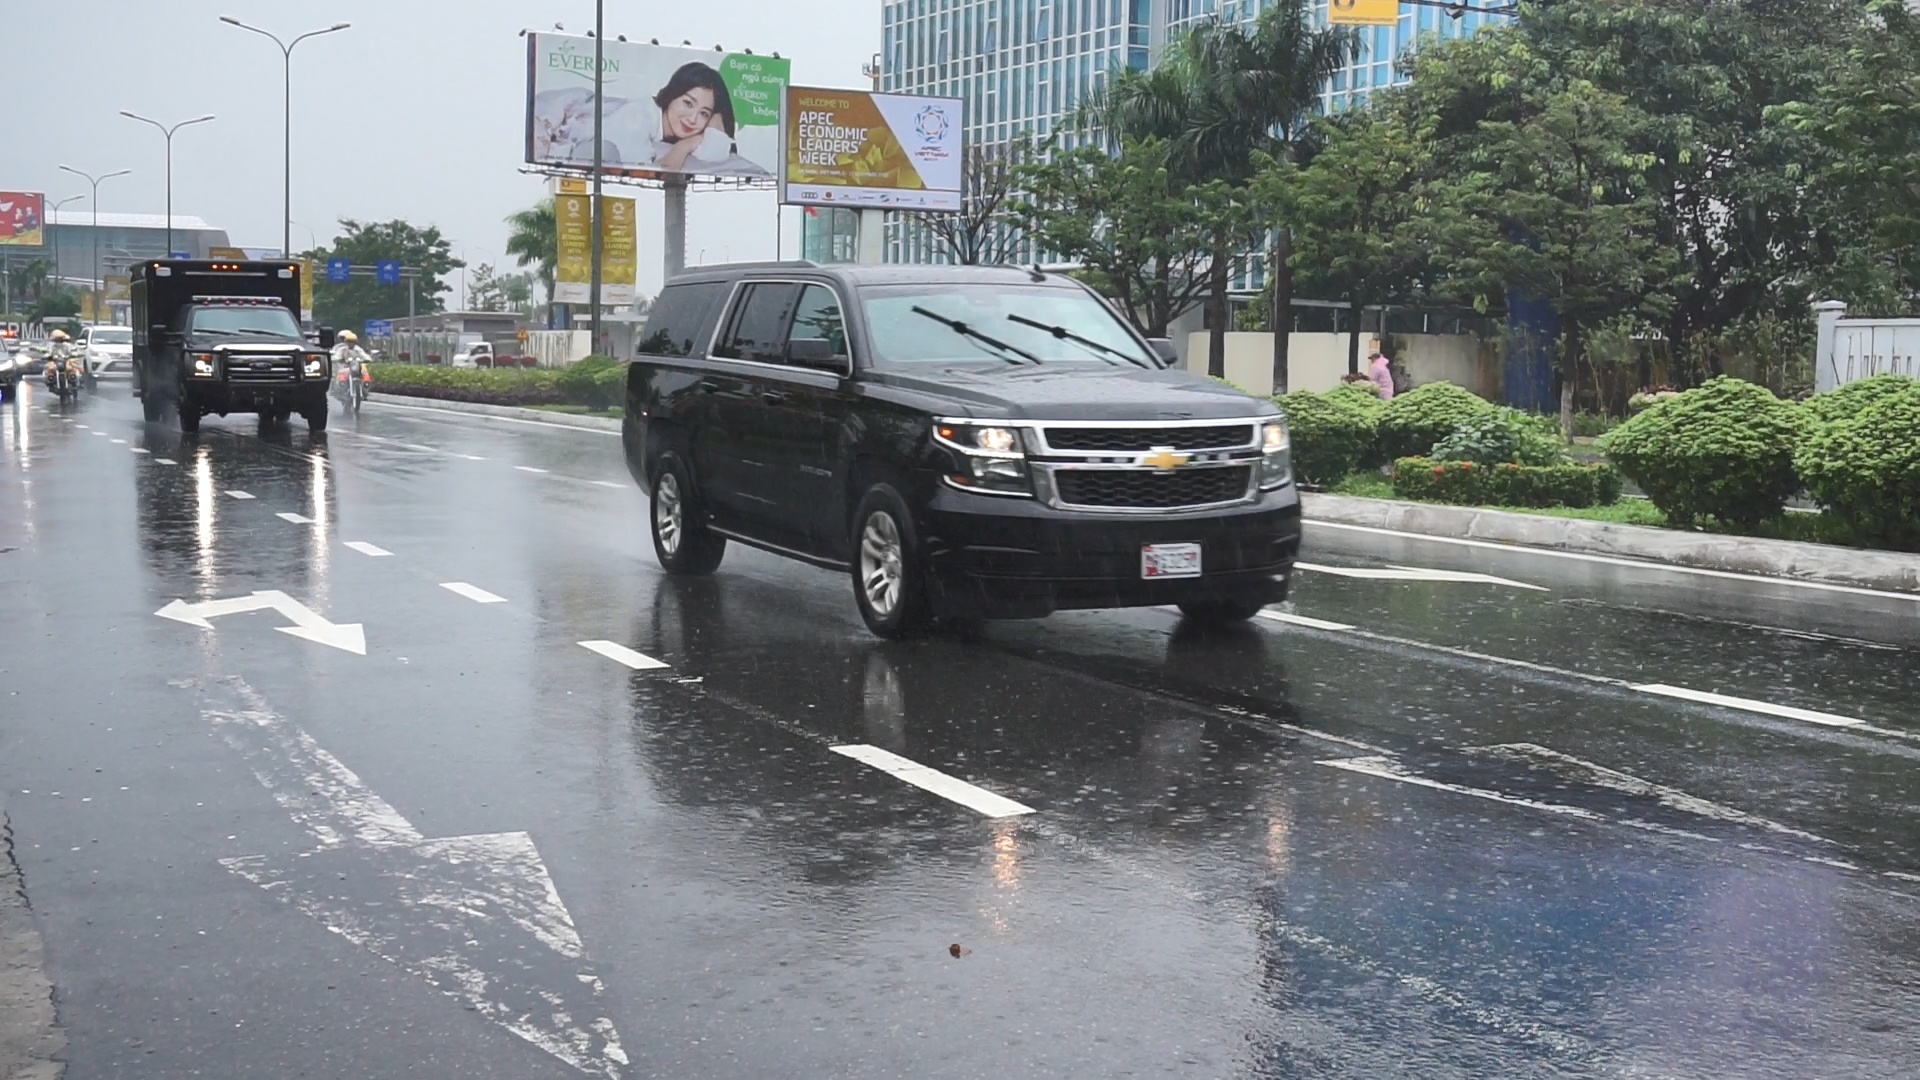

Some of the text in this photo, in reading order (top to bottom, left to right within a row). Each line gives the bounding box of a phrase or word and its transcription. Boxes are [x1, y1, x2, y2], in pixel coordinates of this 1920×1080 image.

[733, 88, 768, 100] EVERON
[799, 97, 849, 109] WELCOME TO
[799, 111, 834, 125] APEC
[799, 124, 868, 141] ECONOMIC
[798, 151, 837, 166] WEEK
